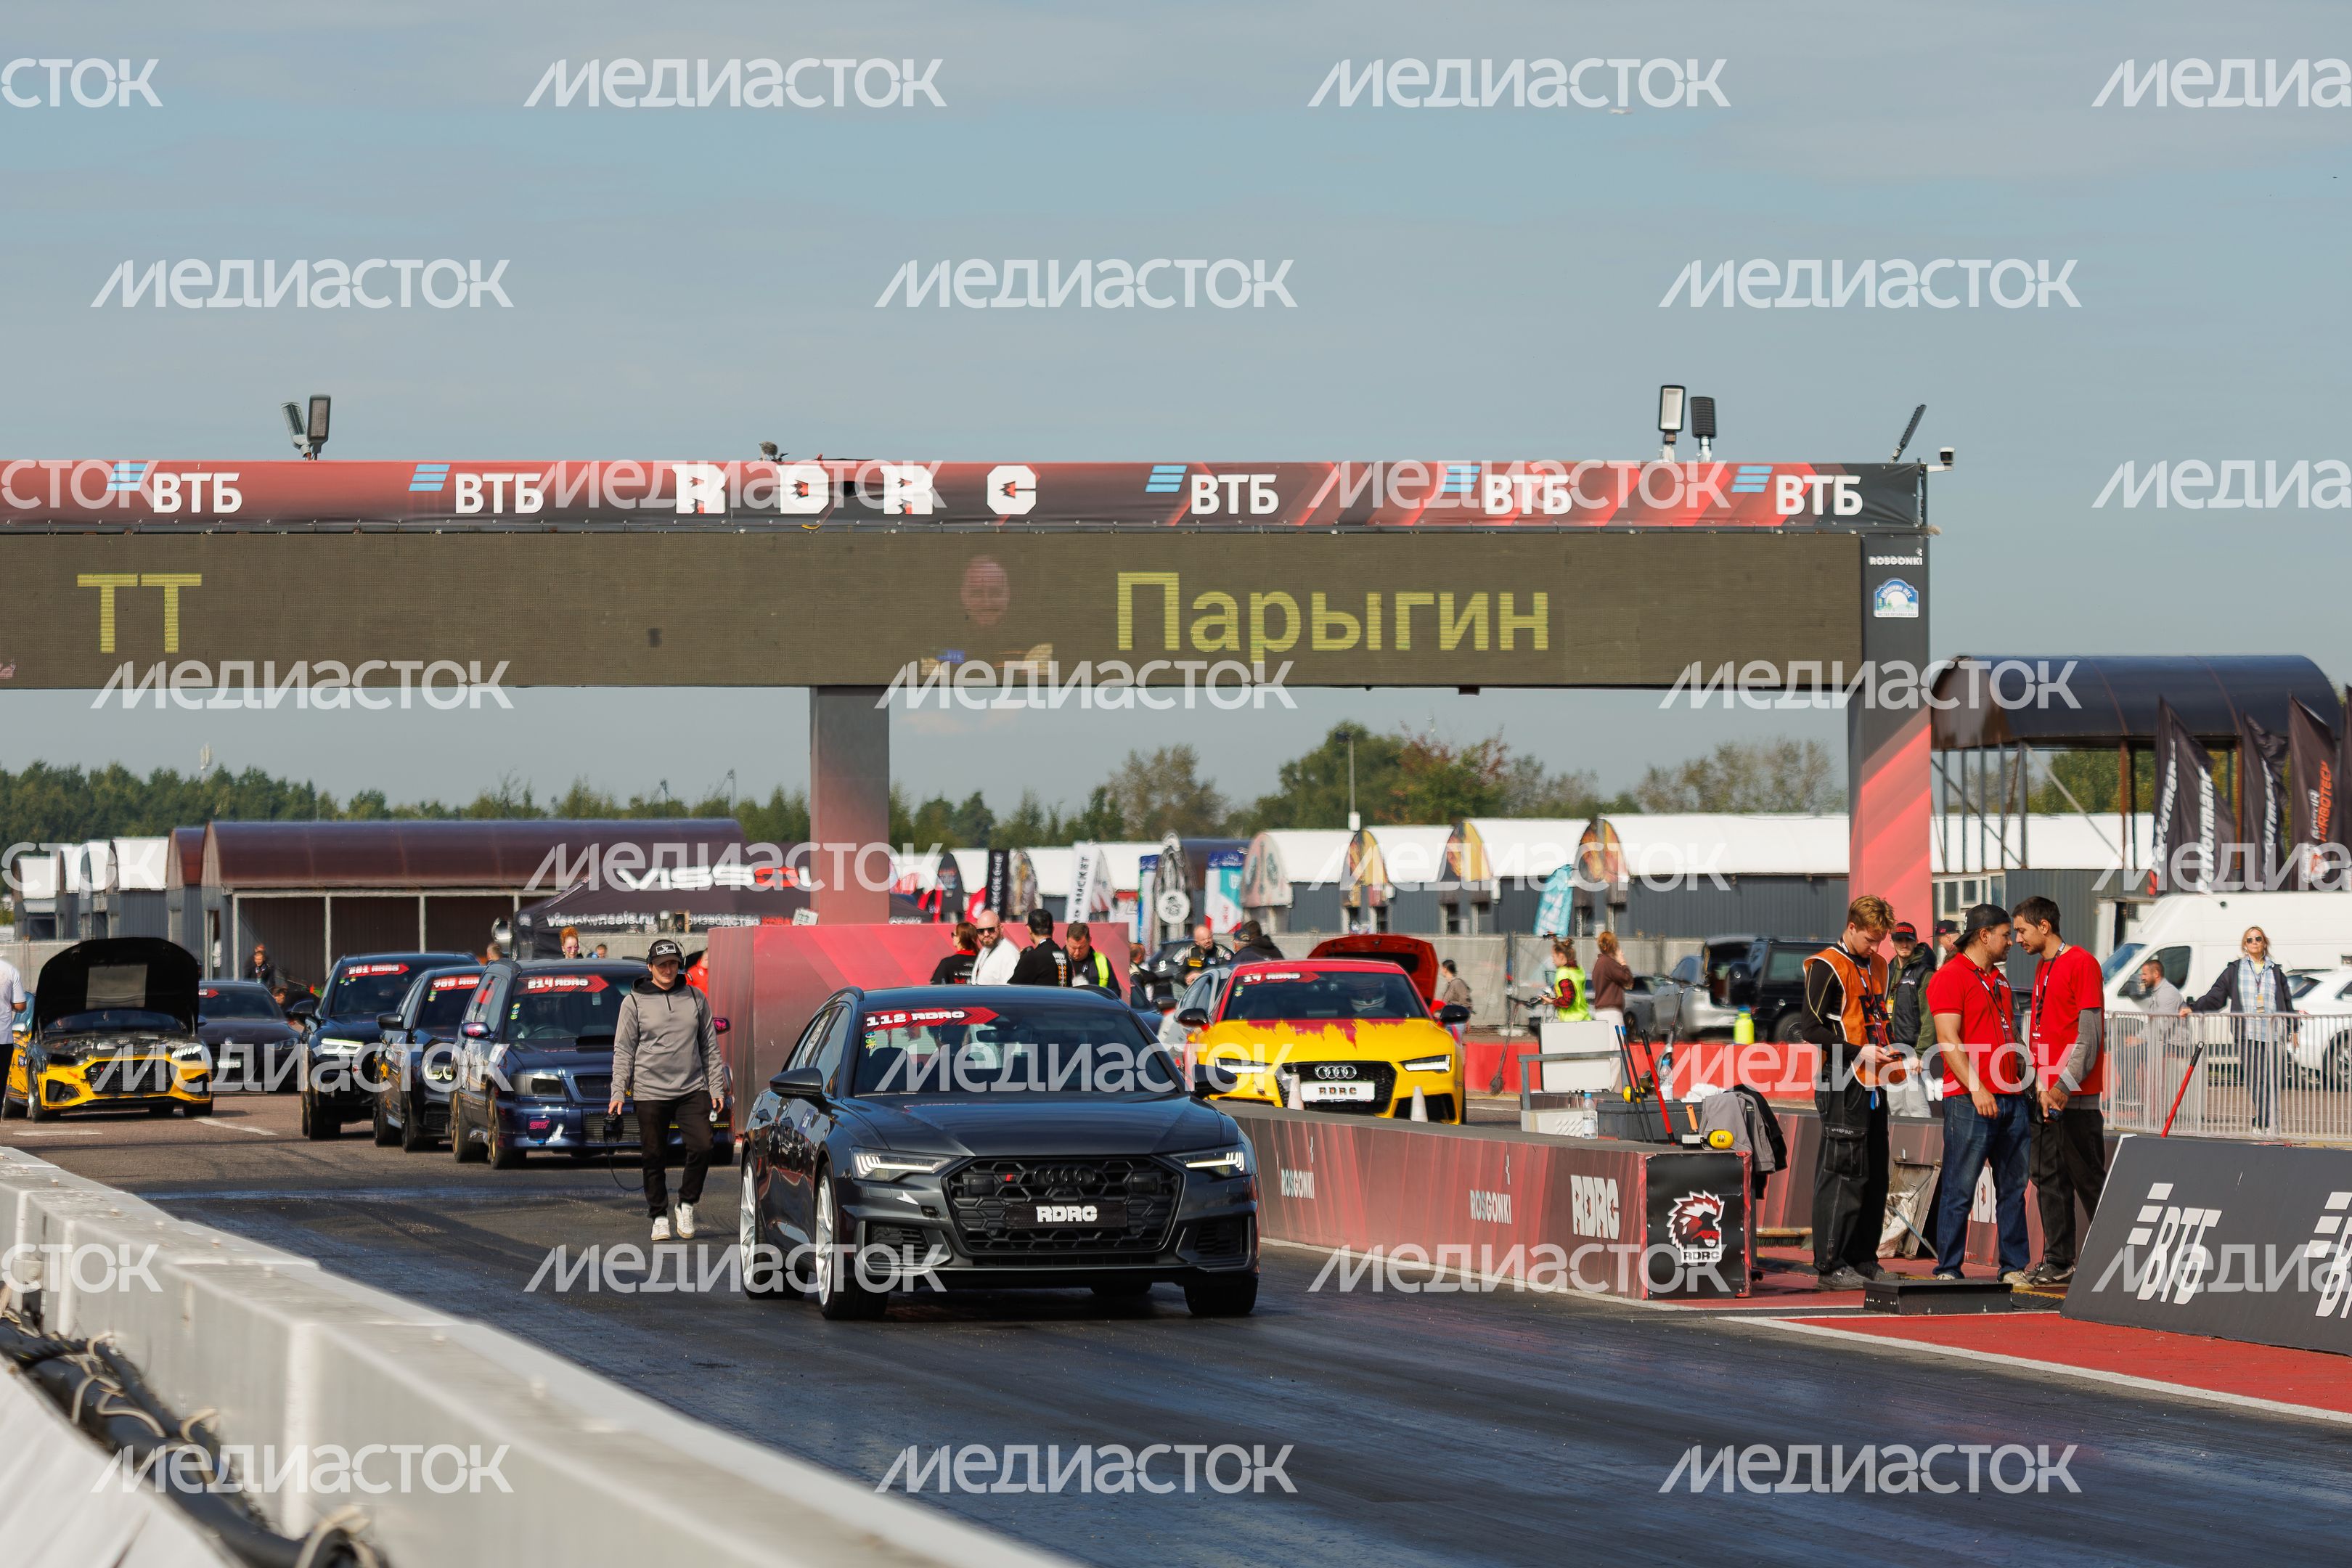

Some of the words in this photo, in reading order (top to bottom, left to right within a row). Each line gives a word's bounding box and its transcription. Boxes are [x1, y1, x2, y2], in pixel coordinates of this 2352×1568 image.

[152, 472, 243, 515] ВТБ
[454, 472, 544, 515] ВТБ
[1191, 473, 1280, 515] ВТБ
[1485, 473, 1573, 516] ВТБ
[1775, 474, 1864, 517] ВТБ
[1116, 571, 1550, 664] Парыгин
[528, 979, 553, 989] 214
[866, 1013, 907, 1027] 112
[911, 1010, 965, 1021] RDRC
[1318, 1087, 1357, 1096] RDRC
[1280, 1168, 1315, 1200] ROSGONKI
[1036, 1205, 1098, 1223] RDRC
[1469, 1190, 1513, 1225] ROSGONKI
[1570, 1174, 1620, 1241] RDRC
[1683, 1250, 1720, 1261] RDRC
[2136, 1206, 2223, 1305] ВТБ
